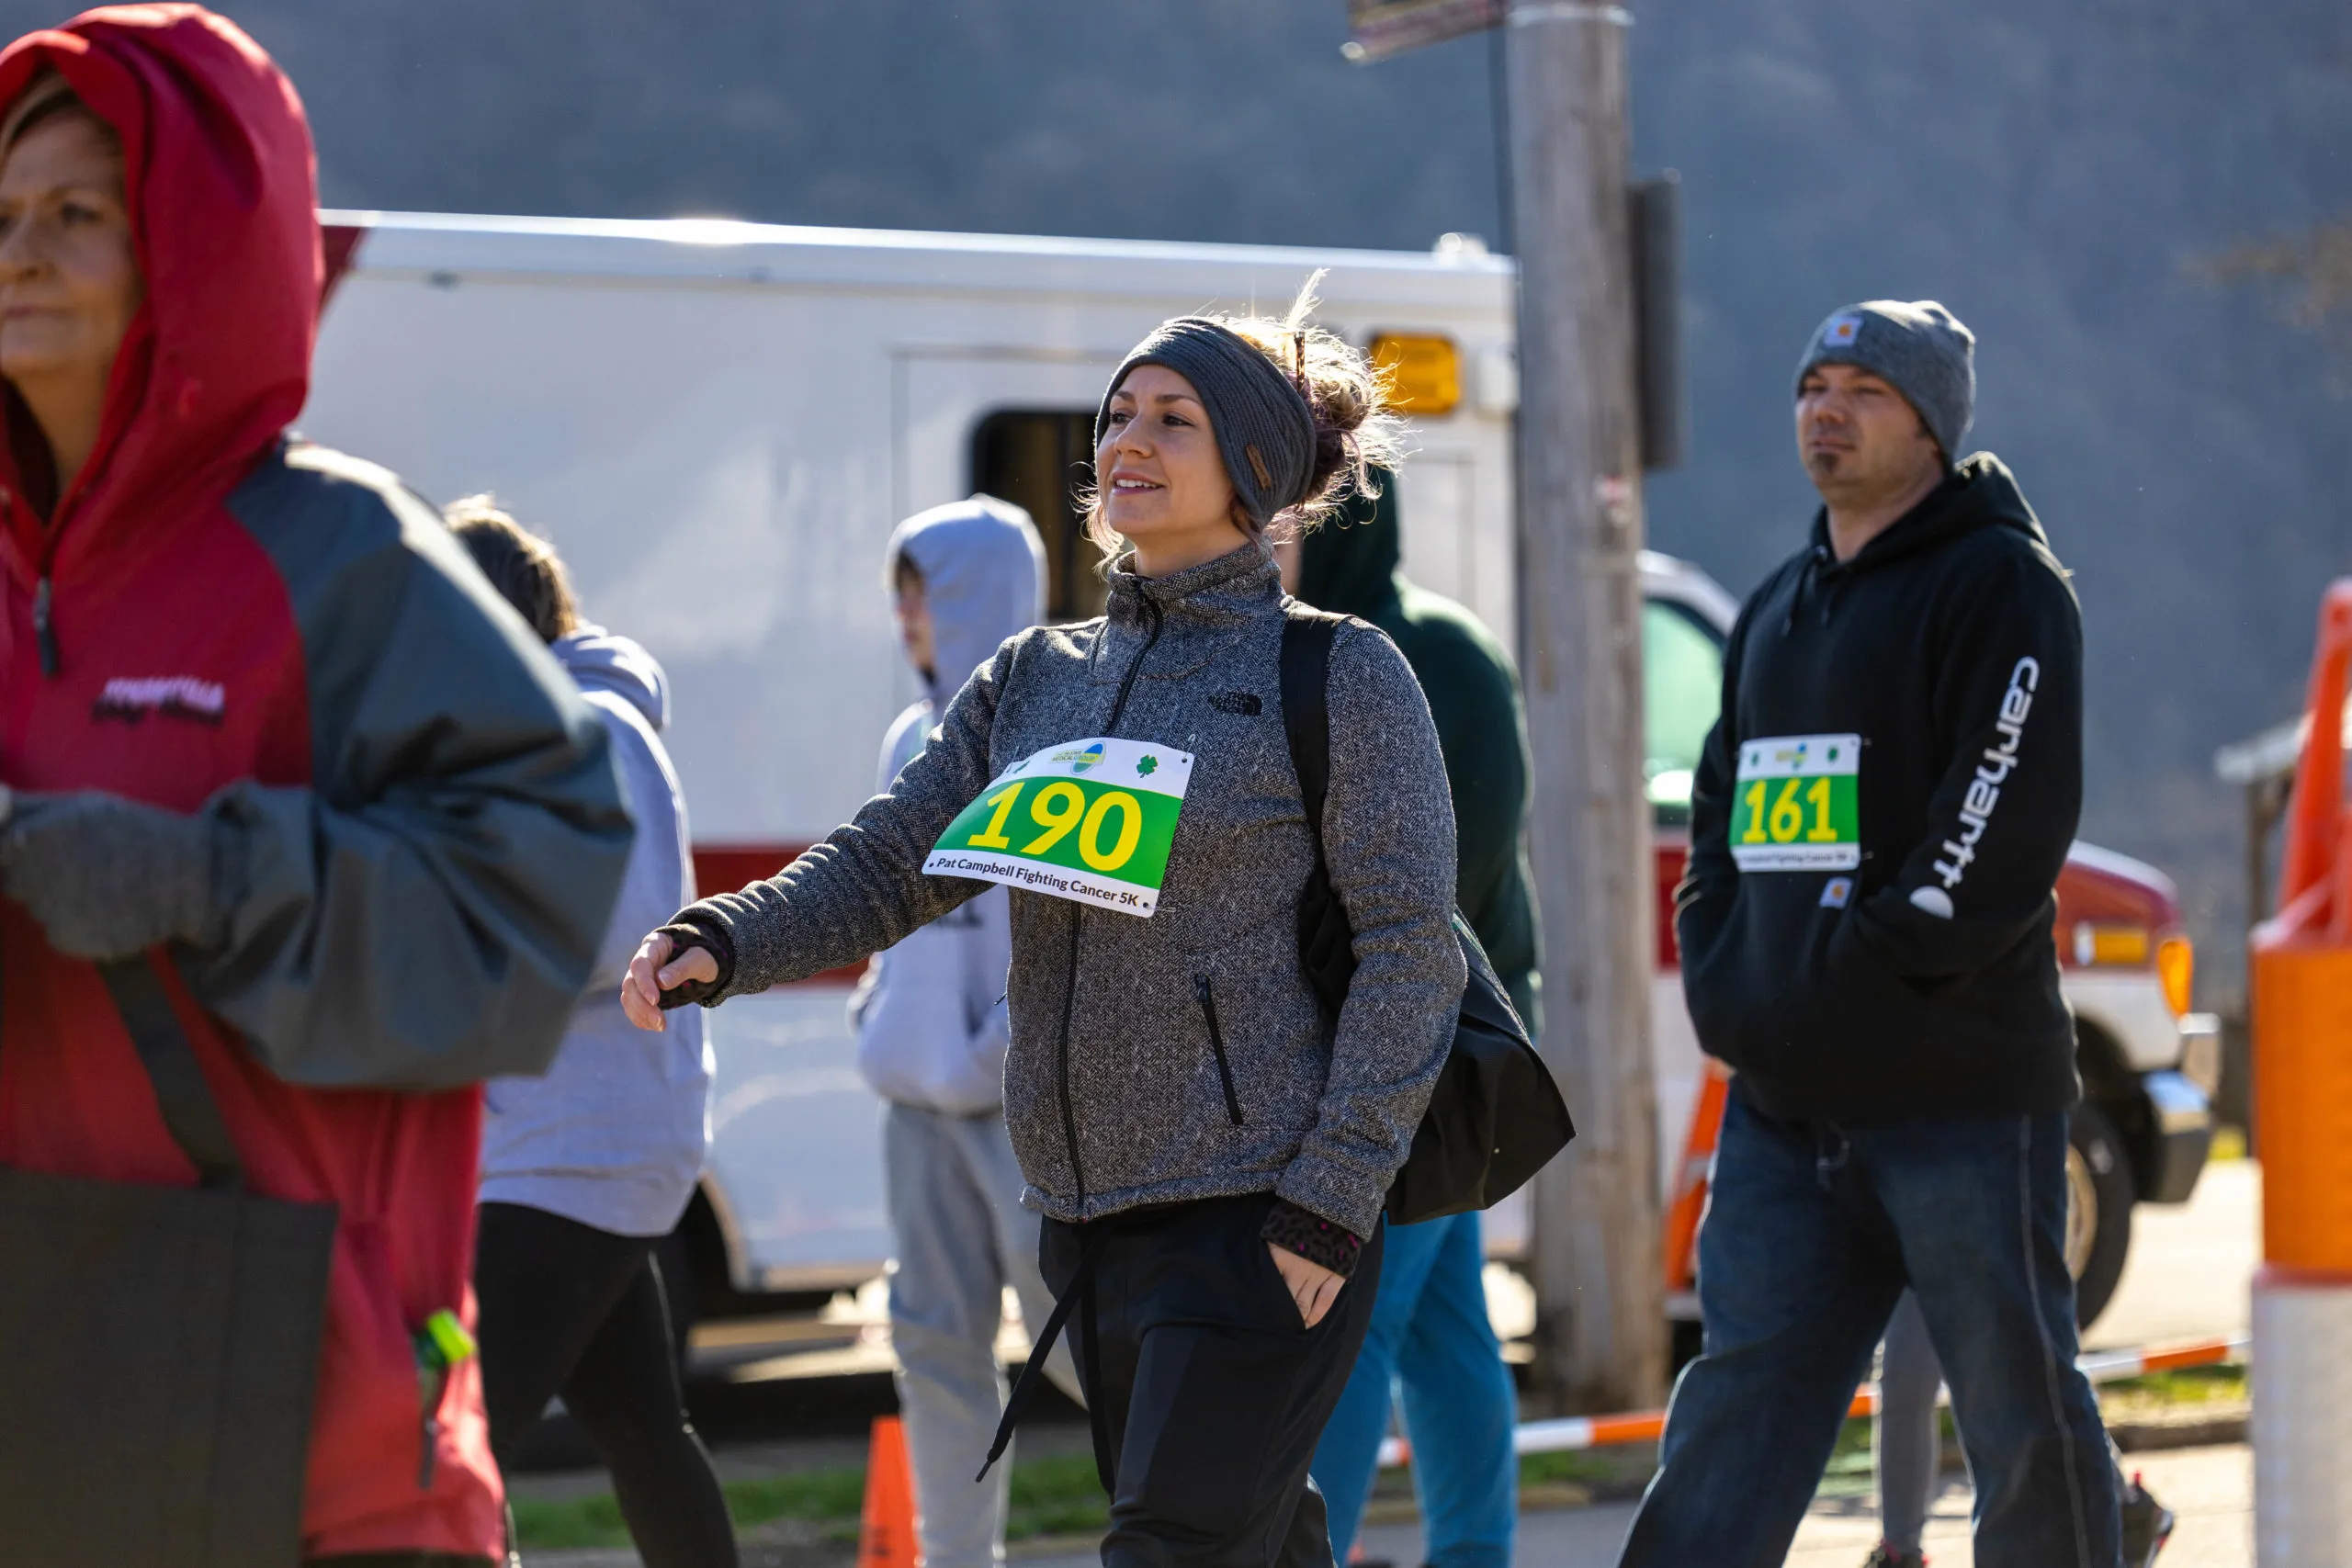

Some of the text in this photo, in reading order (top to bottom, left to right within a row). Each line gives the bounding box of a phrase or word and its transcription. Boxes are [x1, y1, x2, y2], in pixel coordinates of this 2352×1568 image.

[1742, 777, 1838, 843] 161
[1933, 656, 2040, 888] carhartt
[967, 782, 1142, 872] 190
[936, 858, 1140, 907] Pat Campbell Fighting Cancer 5K
